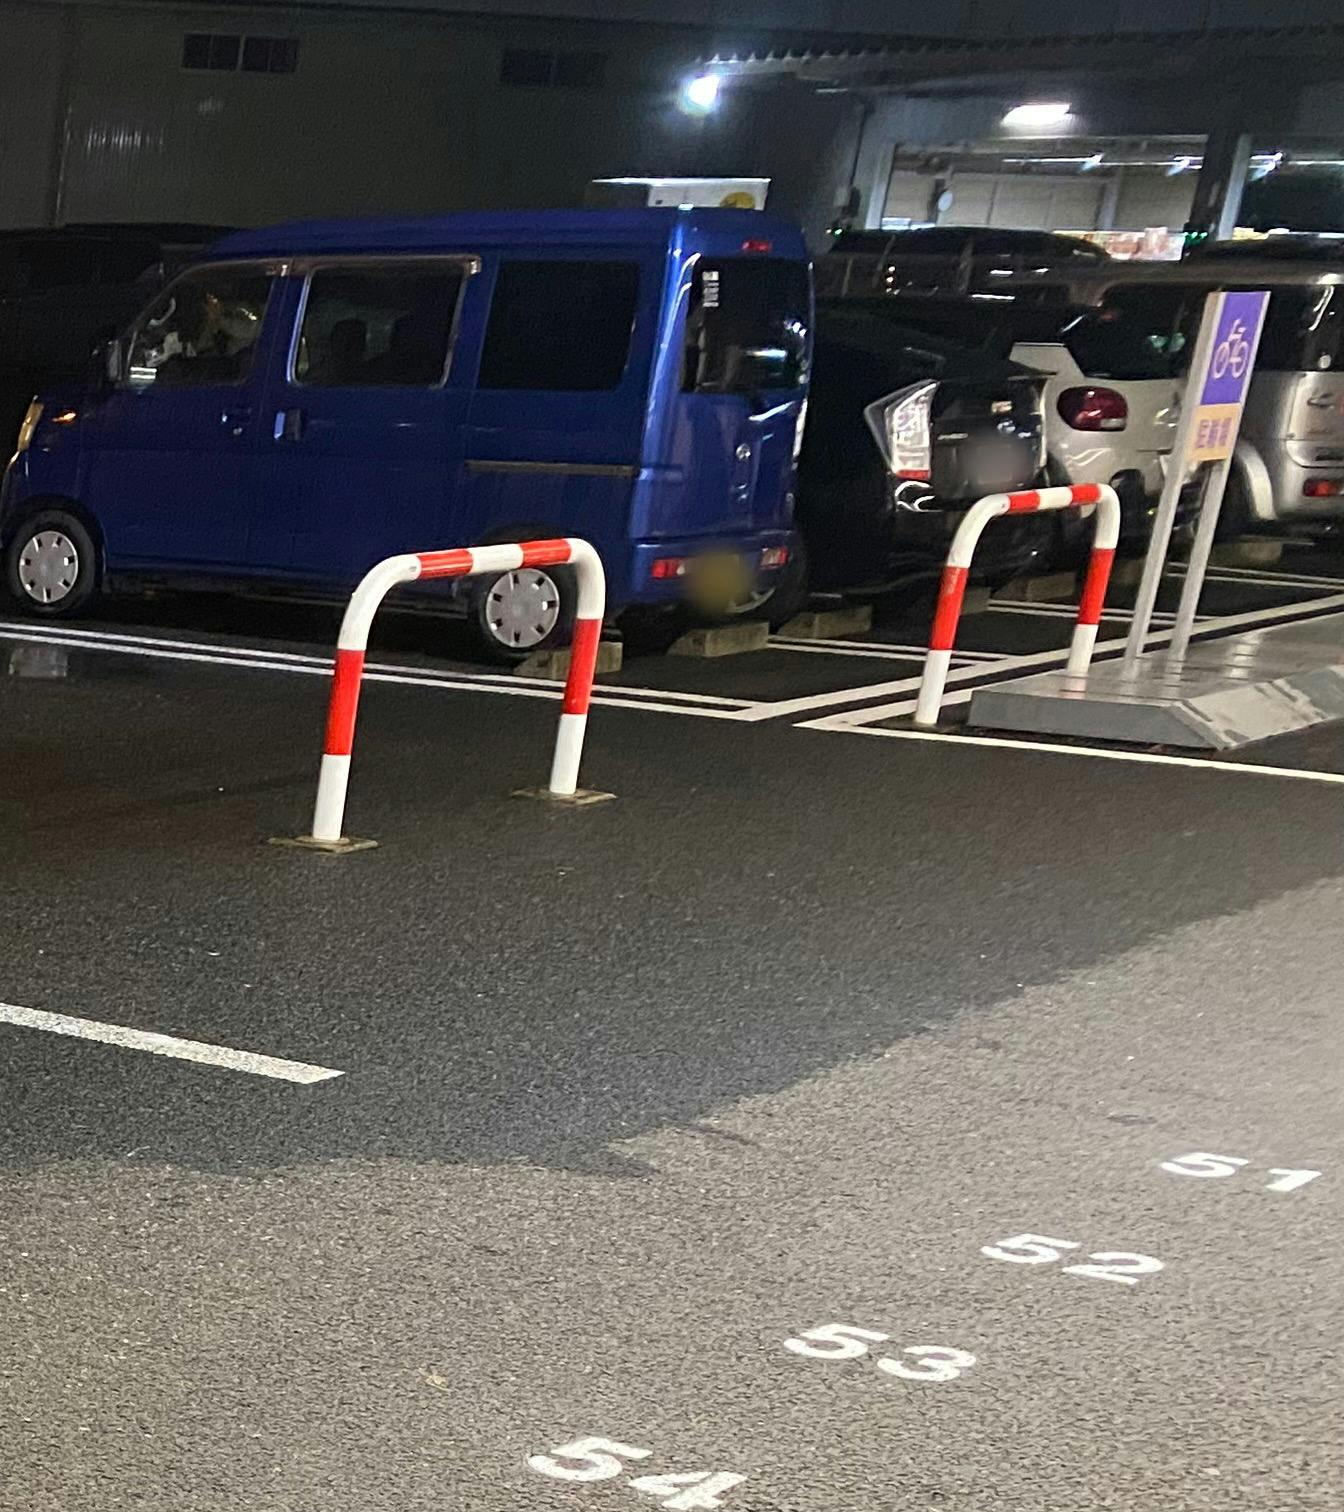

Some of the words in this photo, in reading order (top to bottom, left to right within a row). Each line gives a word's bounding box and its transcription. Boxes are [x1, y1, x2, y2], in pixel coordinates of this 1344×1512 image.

[1159, 1152, 1322, 1192] 51
[980, 1233, 1165, 1285] 52
[783, 1323, 977, 1382] 53
[527, 1436, 747, 1510] 54
